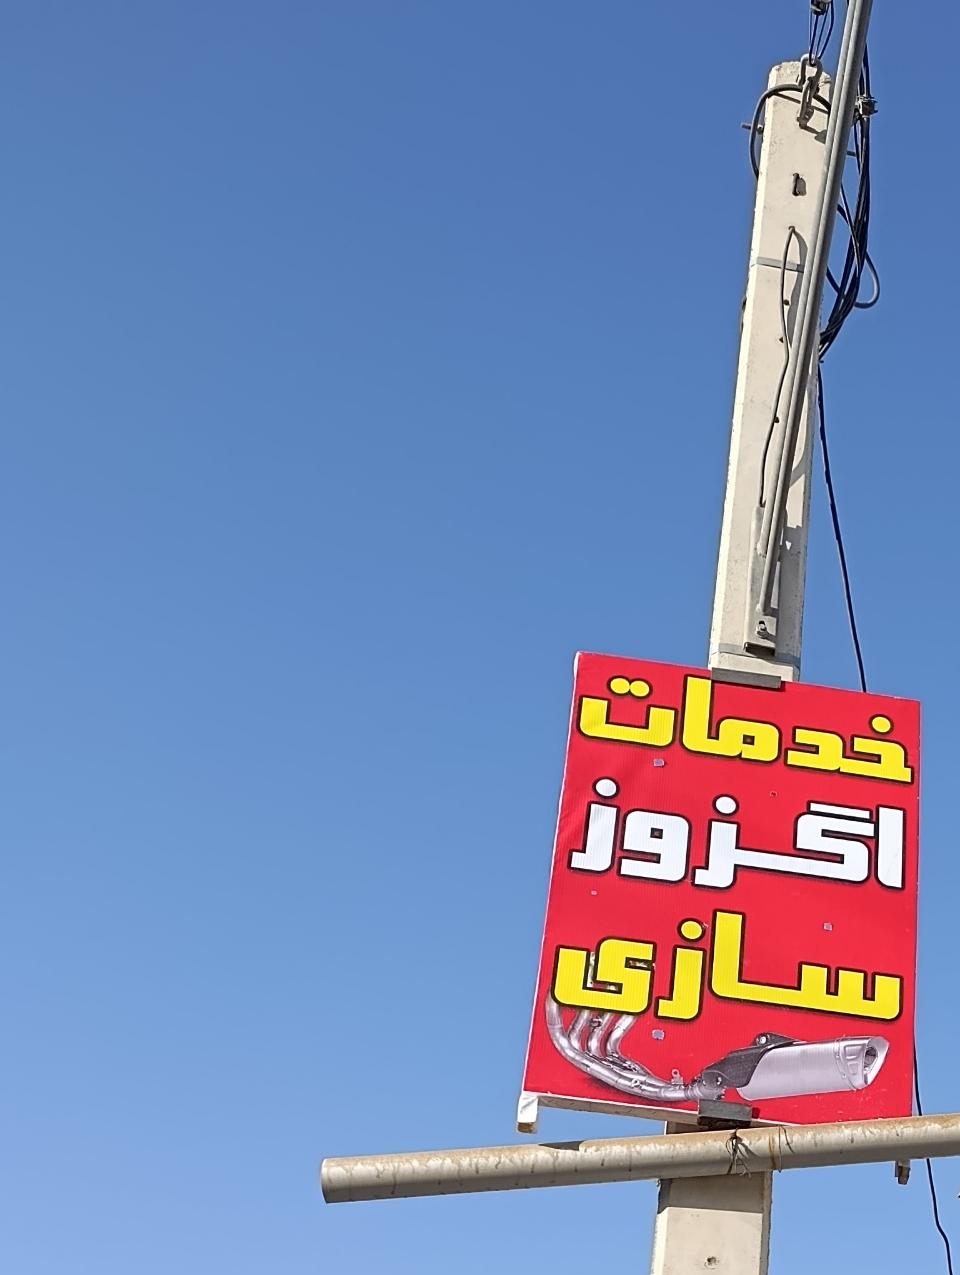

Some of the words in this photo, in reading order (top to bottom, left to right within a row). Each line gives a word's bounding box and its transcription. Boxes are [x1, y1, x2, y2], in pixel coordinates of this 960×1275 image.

[577, 675, 914, 784] خدمات
[569, 777, 906, 891] اگزوز
[552, 909, 904, 1021] سازی
